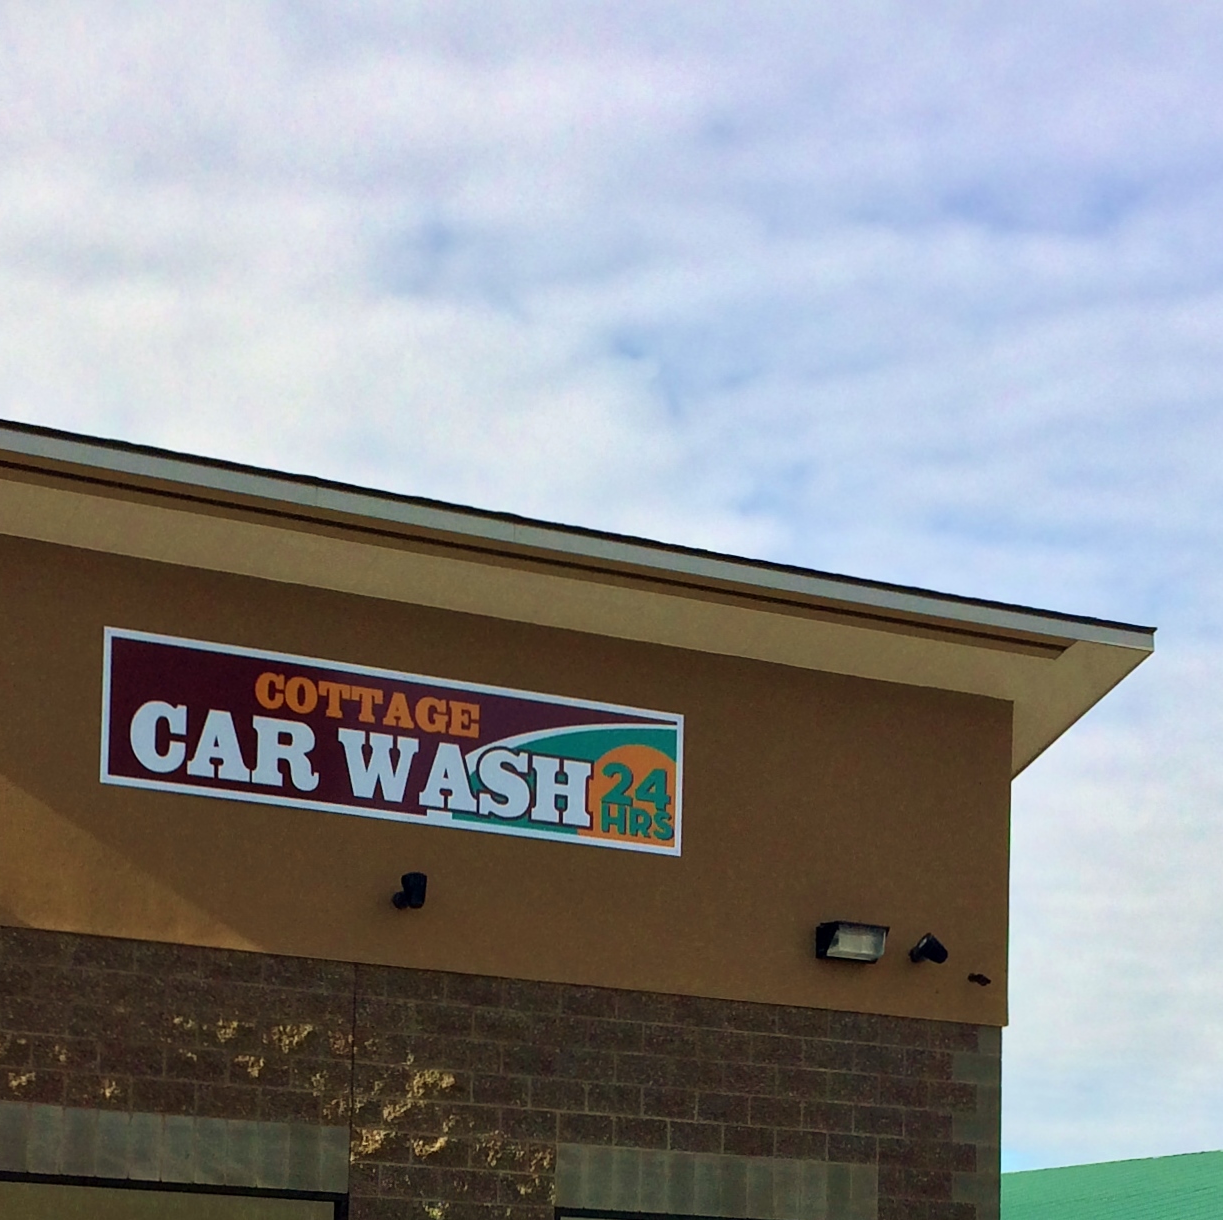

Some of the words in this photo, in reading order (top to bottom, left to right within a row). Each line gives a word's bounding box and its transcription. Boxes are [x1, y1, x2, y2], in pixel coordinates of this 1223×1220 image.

[254, 671, 480, 739] COTTAGE
[129, 700, 320, 792] CAR
[338, 727, 593, 830] WASH
[600, 761, 672, 812] 24
[600, 802, 675, 841] HRS
